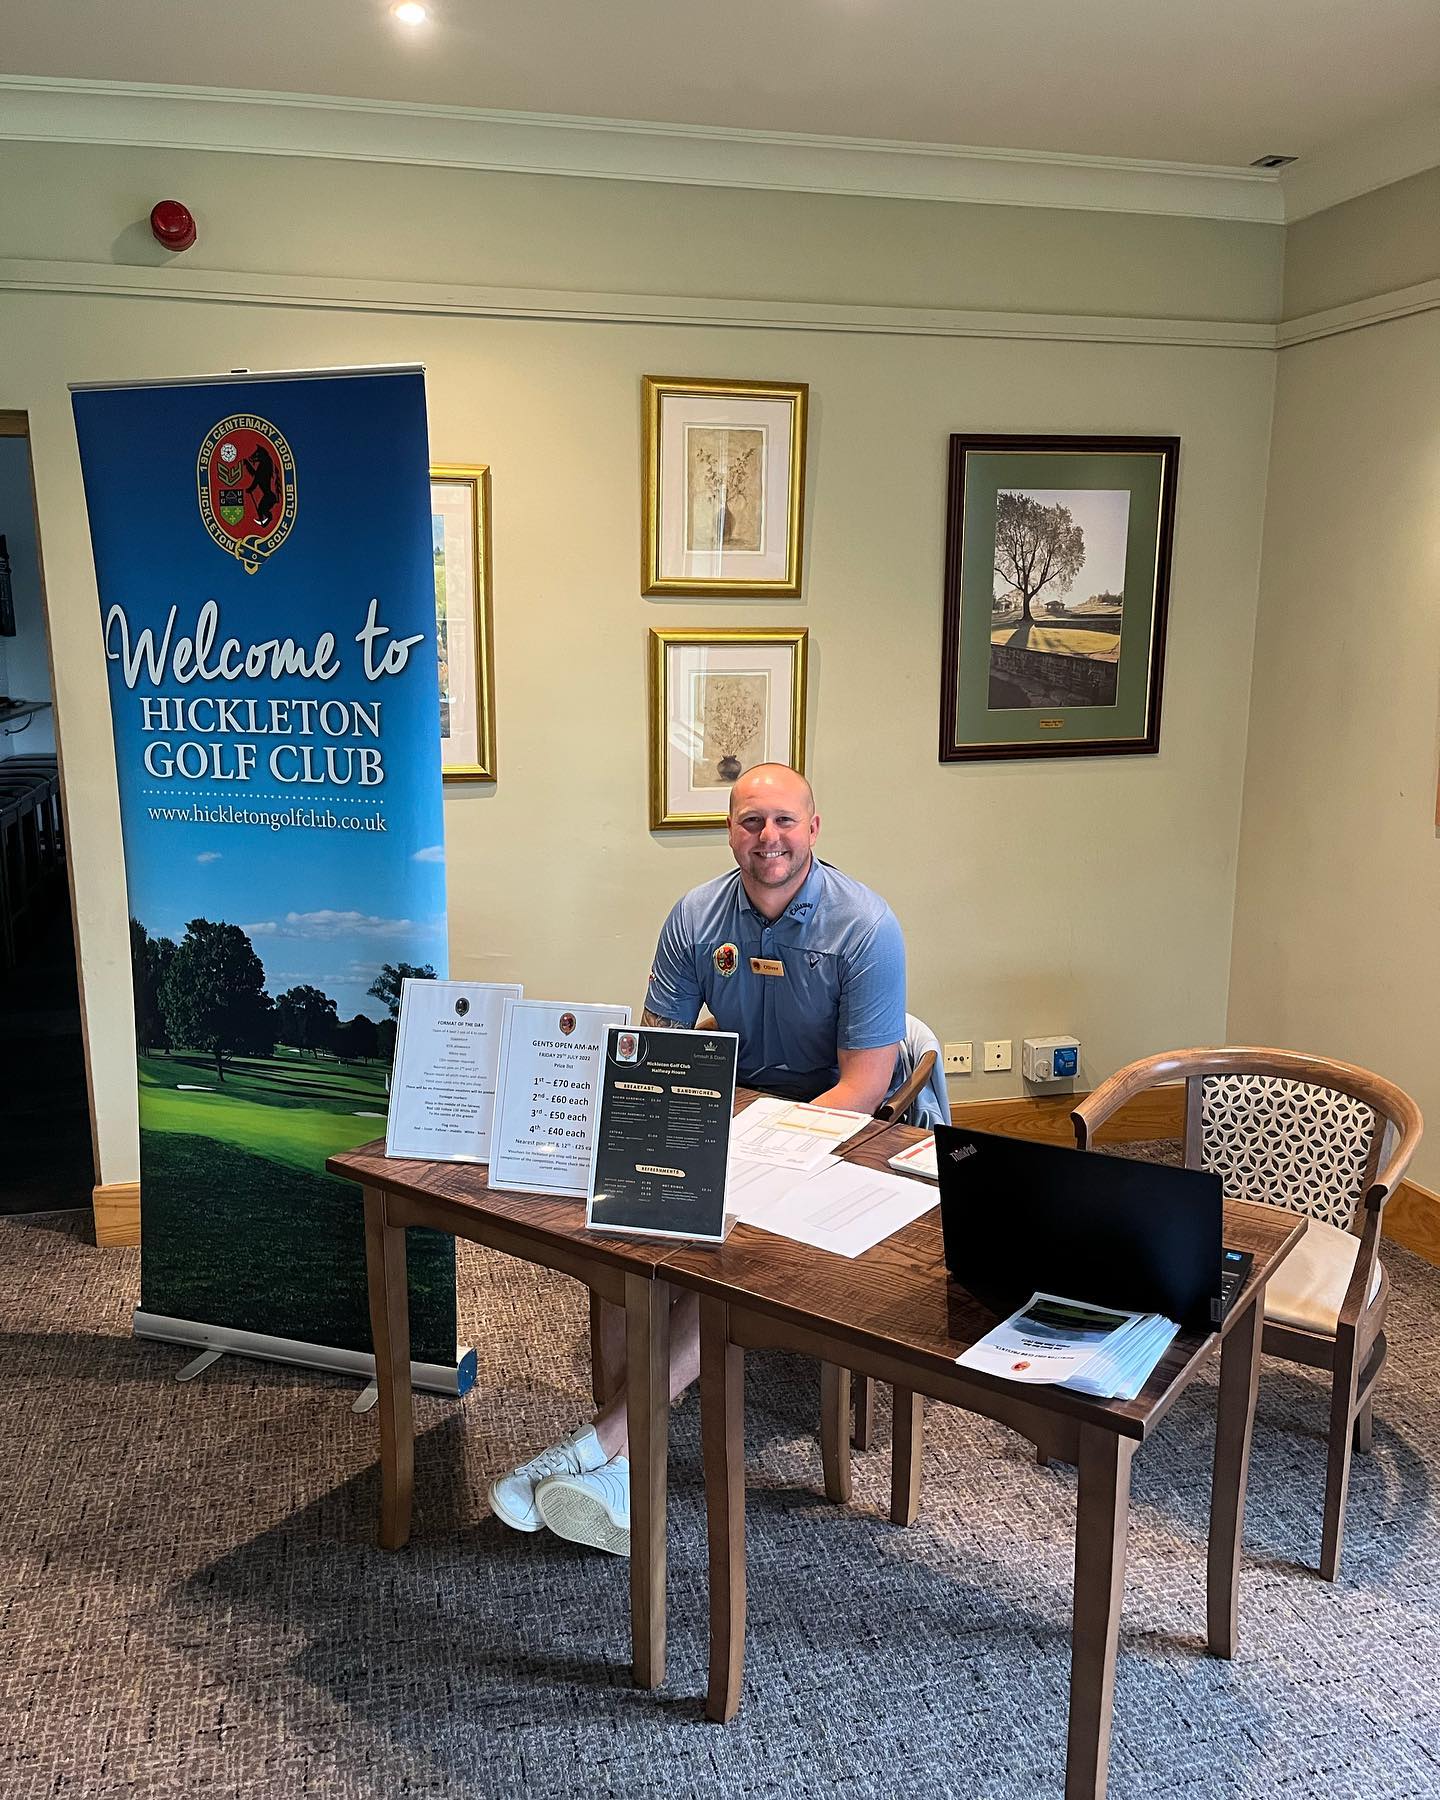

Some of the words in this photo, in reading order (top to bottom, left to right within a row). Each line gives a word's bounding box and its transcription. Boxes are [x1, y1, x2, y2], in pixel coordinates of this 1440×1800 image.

[200, 440, 214, 472] 1909
[212, 417, 275, 440] CENTENARY
[273, 438, 293, 471] 2009
[200, 486, 235, 550] HICKLETON
[267, 521, 288, 549] GOLF
[285, 484, 295, 518] CLUB
[106, 599, 340, 689] Welcome
[355, 598, 425, 681] to
[139, 697, 382, 738] HICKLETON
[143, 741, 257, 780] GOLF
[269, 744, 385, 786] CLUB
[147, 804, 388, 832] www.hickletongolfclub.co.uk
[532, 1040, 553, 1048] GENTS
[554, 1041, 573, 1049] OPEN
[573, 1043, 599, 1051] AM-AM
[534, 1077, 545, 1086] 1st
[552, 1079, 569, 1088] £70
[570, 1081, 591, 1090] each
[623, 1083, 655, 1091] BREAKFAST
[532, 1093, 545, 1101] 2nd
[551, 1095, 567, 1104] £60
[569, 1097, 589, 1106] each
[676, 1088, 714, 1096] SANDWICHES
[530, 1109, 543, 1118] 3rd
[549, 1111, 565, 1120] £50
[567, 1113, 587, 1122] each
[529, 1124, 541, 1133] 4th
[547, 1127, 564, 1136] £40
[565, 1129, 586, 1138] each
[949, 1143, 978, 1162] ThinkPad
